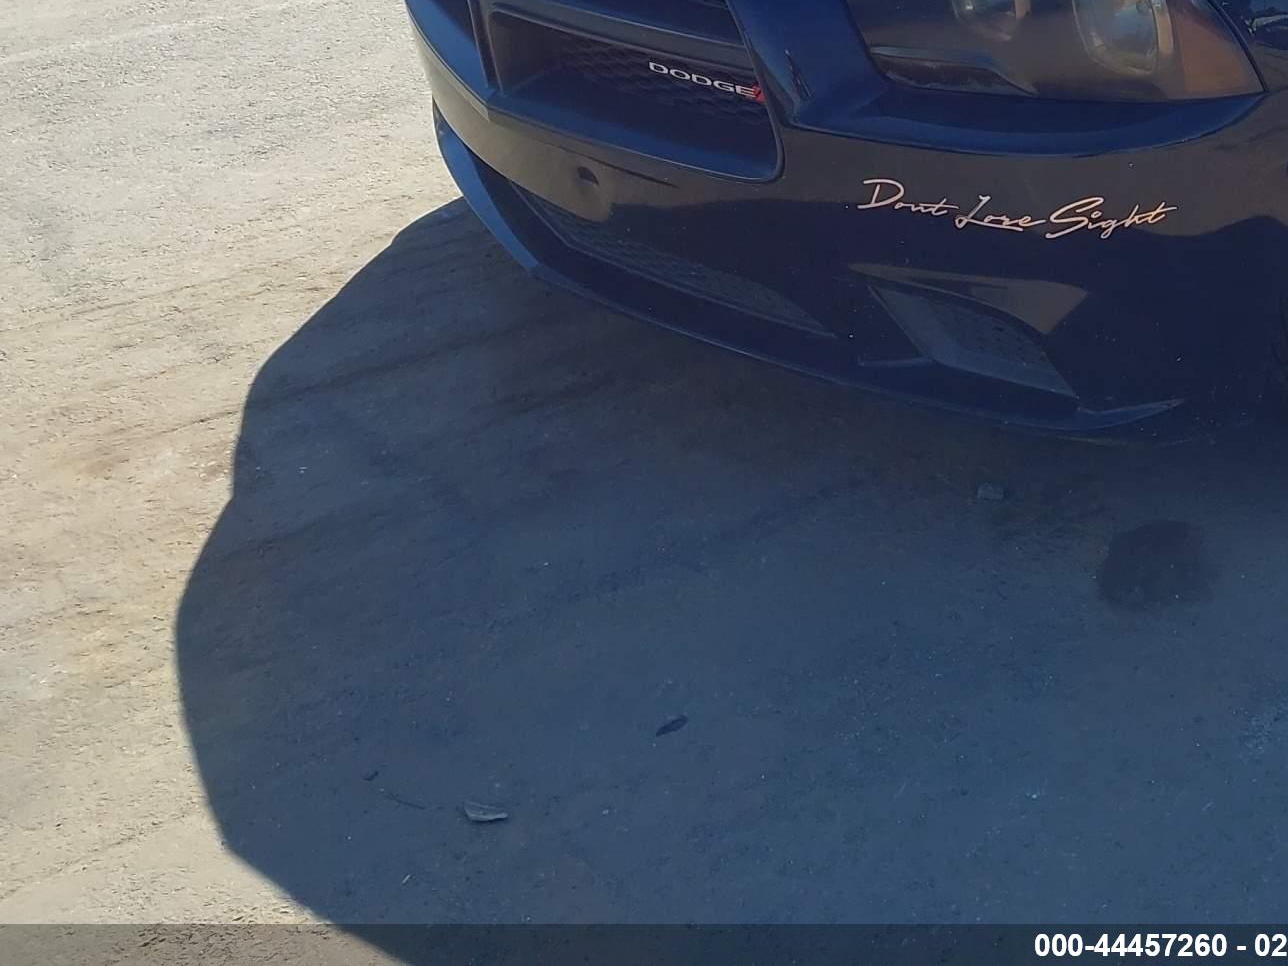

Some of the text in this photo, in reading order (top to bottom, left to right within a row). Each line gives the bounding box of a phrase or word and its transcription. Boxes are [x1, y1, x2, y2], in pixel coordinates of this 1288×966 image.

[648, 62, 756, 98] DODGE
[857, 179, 959, 216] Dont
[1045, 197, 1177, 239] Sight
